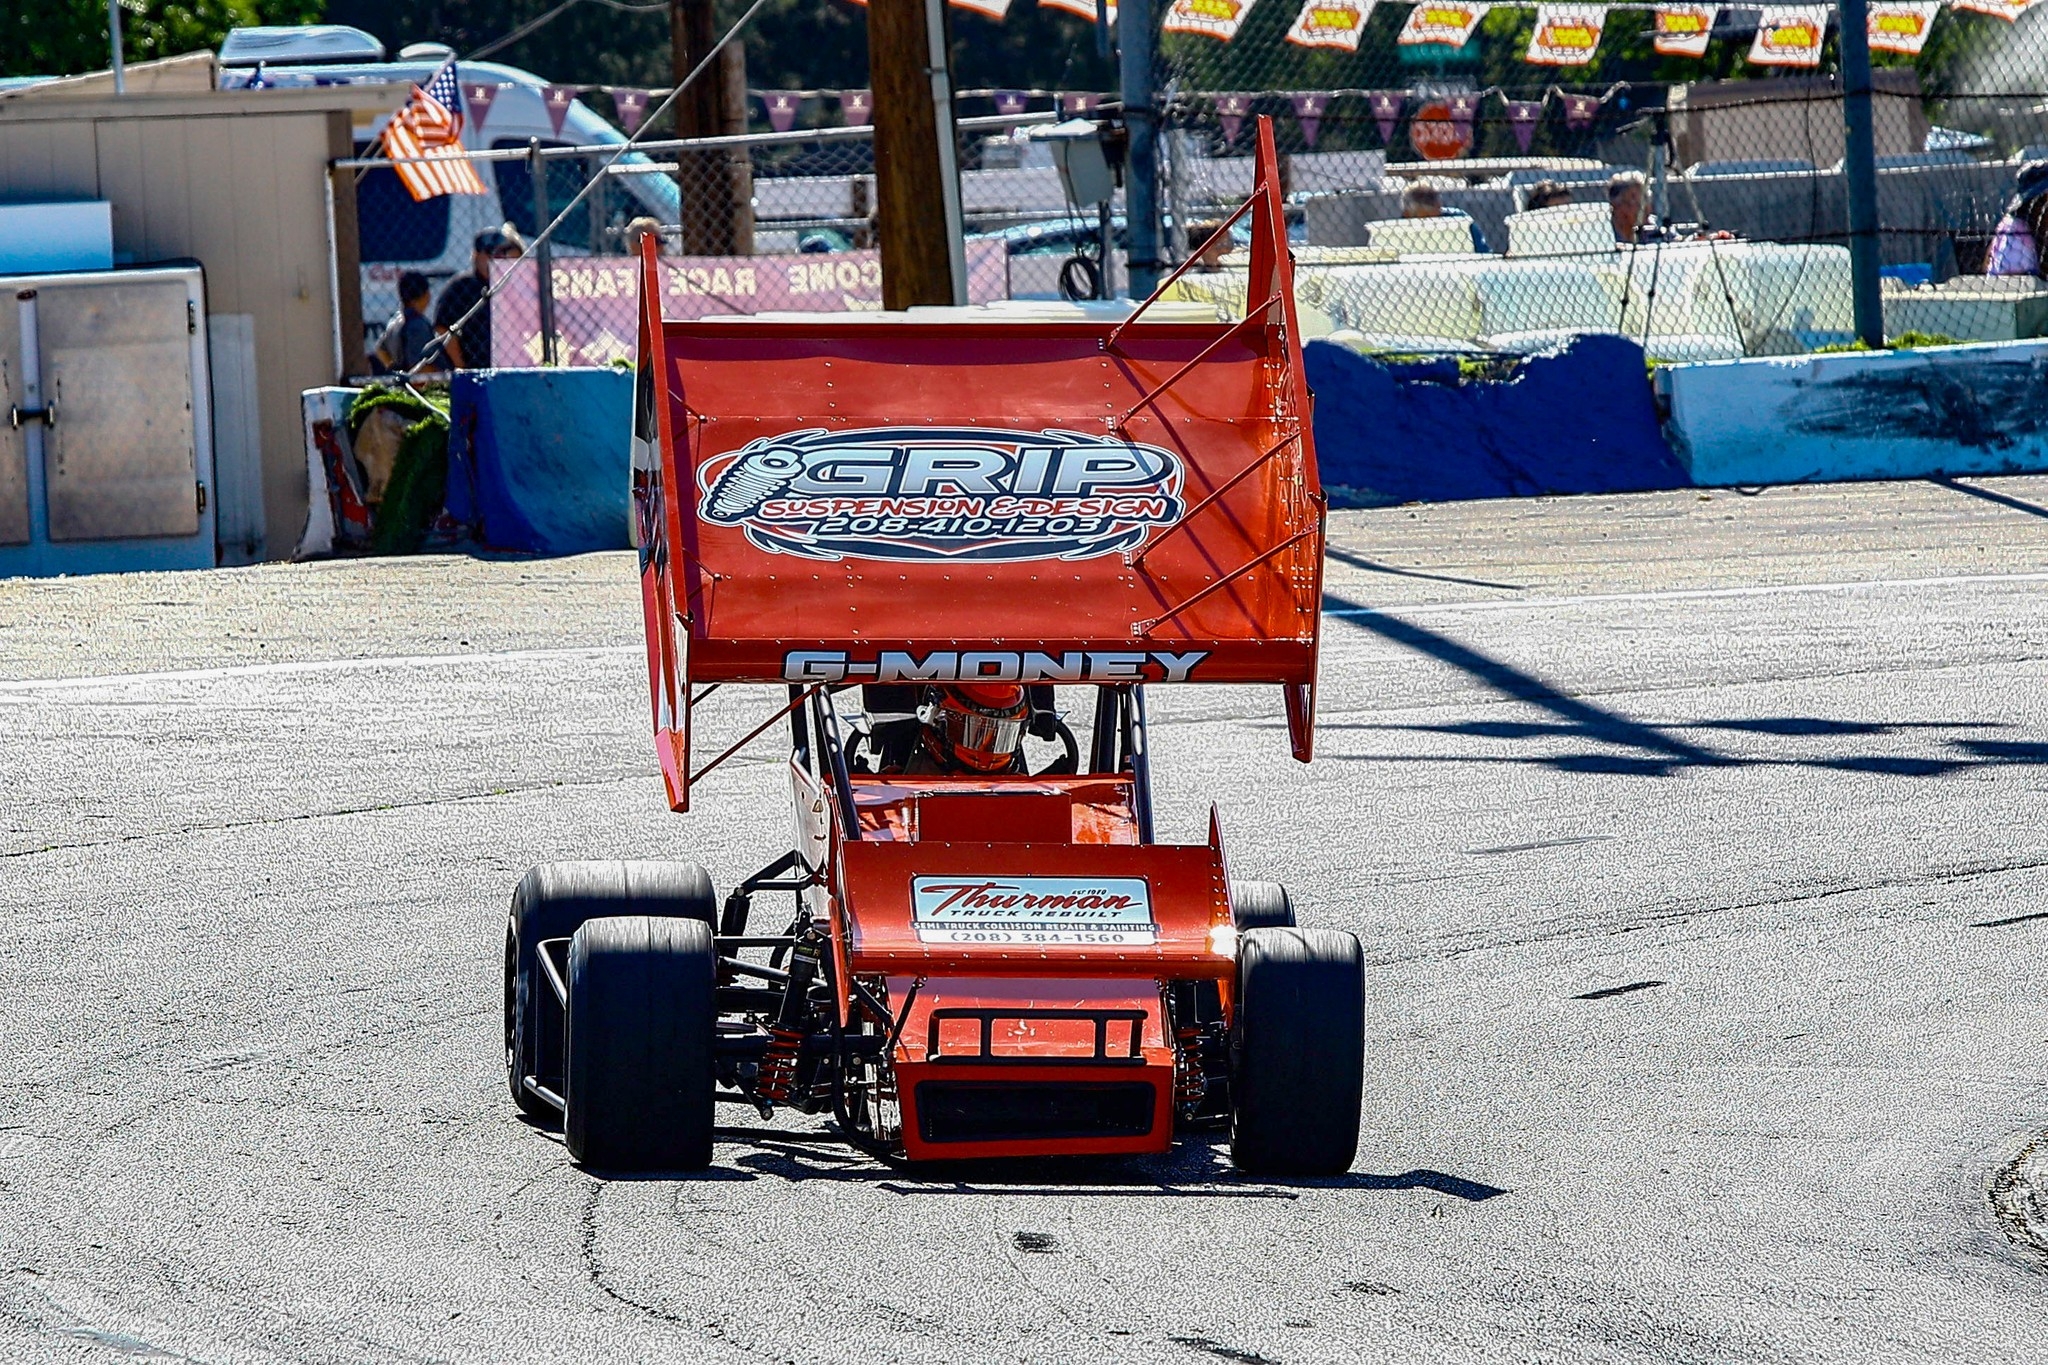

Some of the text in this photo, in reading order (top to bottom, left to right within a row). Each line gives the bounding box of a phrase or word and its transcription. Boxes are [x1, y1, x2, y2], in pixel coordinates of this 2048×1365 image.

[788, 448, 1164, 494] GRIP
[818, 517, 1101, 533] 208-410-1203
[784, 651, 1208, 682] G-MONEY
[920, 882, 1143, 916] Thurman
[914, 922, 940, 930] SEMI
[943, 922, 980, 930] TRUCK
[984, 922, 1042, 931] COLLISION
[1046, 923, 1086, 932] REPAIR
[1102, 924, 1155, 932] PAINTING
[951, 932, 1124, 943] (208) 384-1560
